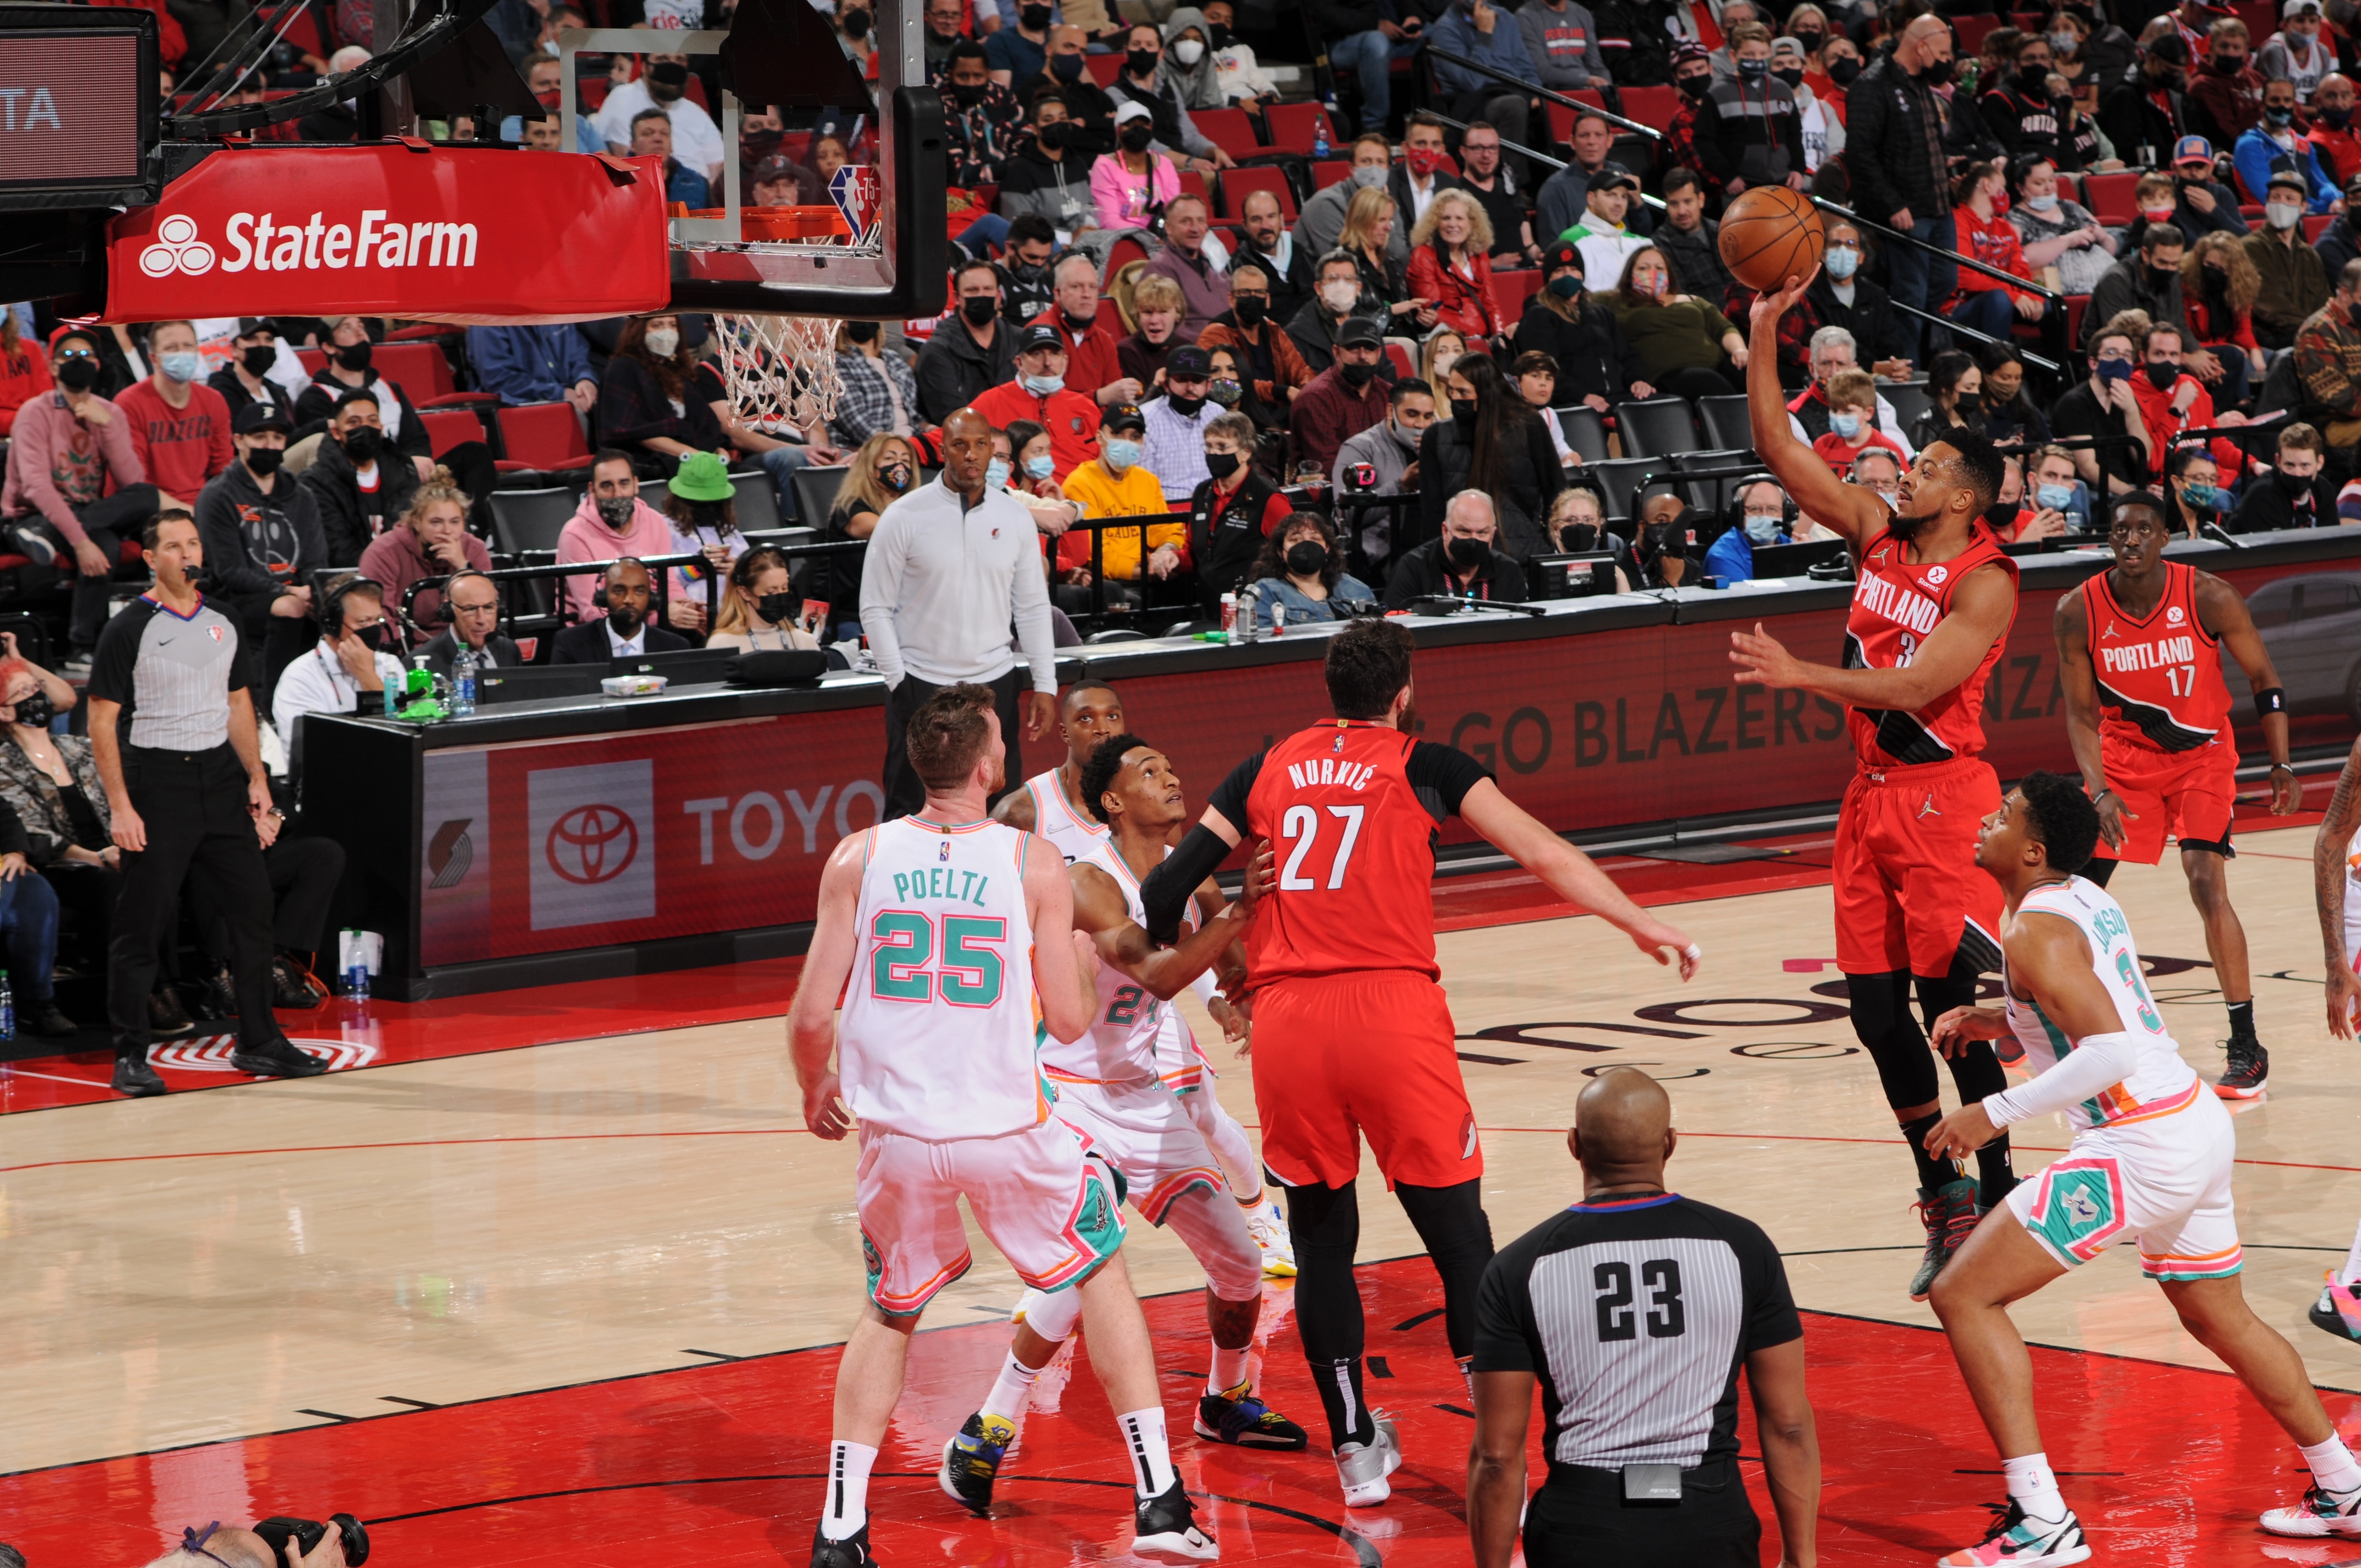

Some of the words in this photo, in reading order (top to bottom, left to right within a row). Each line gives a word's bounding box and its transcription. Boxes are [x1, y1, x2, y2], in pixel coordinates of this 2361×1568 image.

[0, 88, 61, 130] TA
[863, 177, 875, 200] 75
[1859, 569, 1940, 635] PORTLAND
[1894, 632, 1917, 669] 3
[2101, 636, 2195, 673] PORTLAND
[2165, 665, 2196, 698] 17
[1449, 706, 1552, 775] GO
[1287, 758, 1378, 791] NURKIĆ
[684, 780, 885, 865] TOYO
[1279, 804, 1366, 891] 27
[893, 868, 988, 907] POELTL
[871, 909, 1007, 1009] 25
[2115, 947, 2166, 1036] 3
[1593, 1258, 1686, 1343] 23
